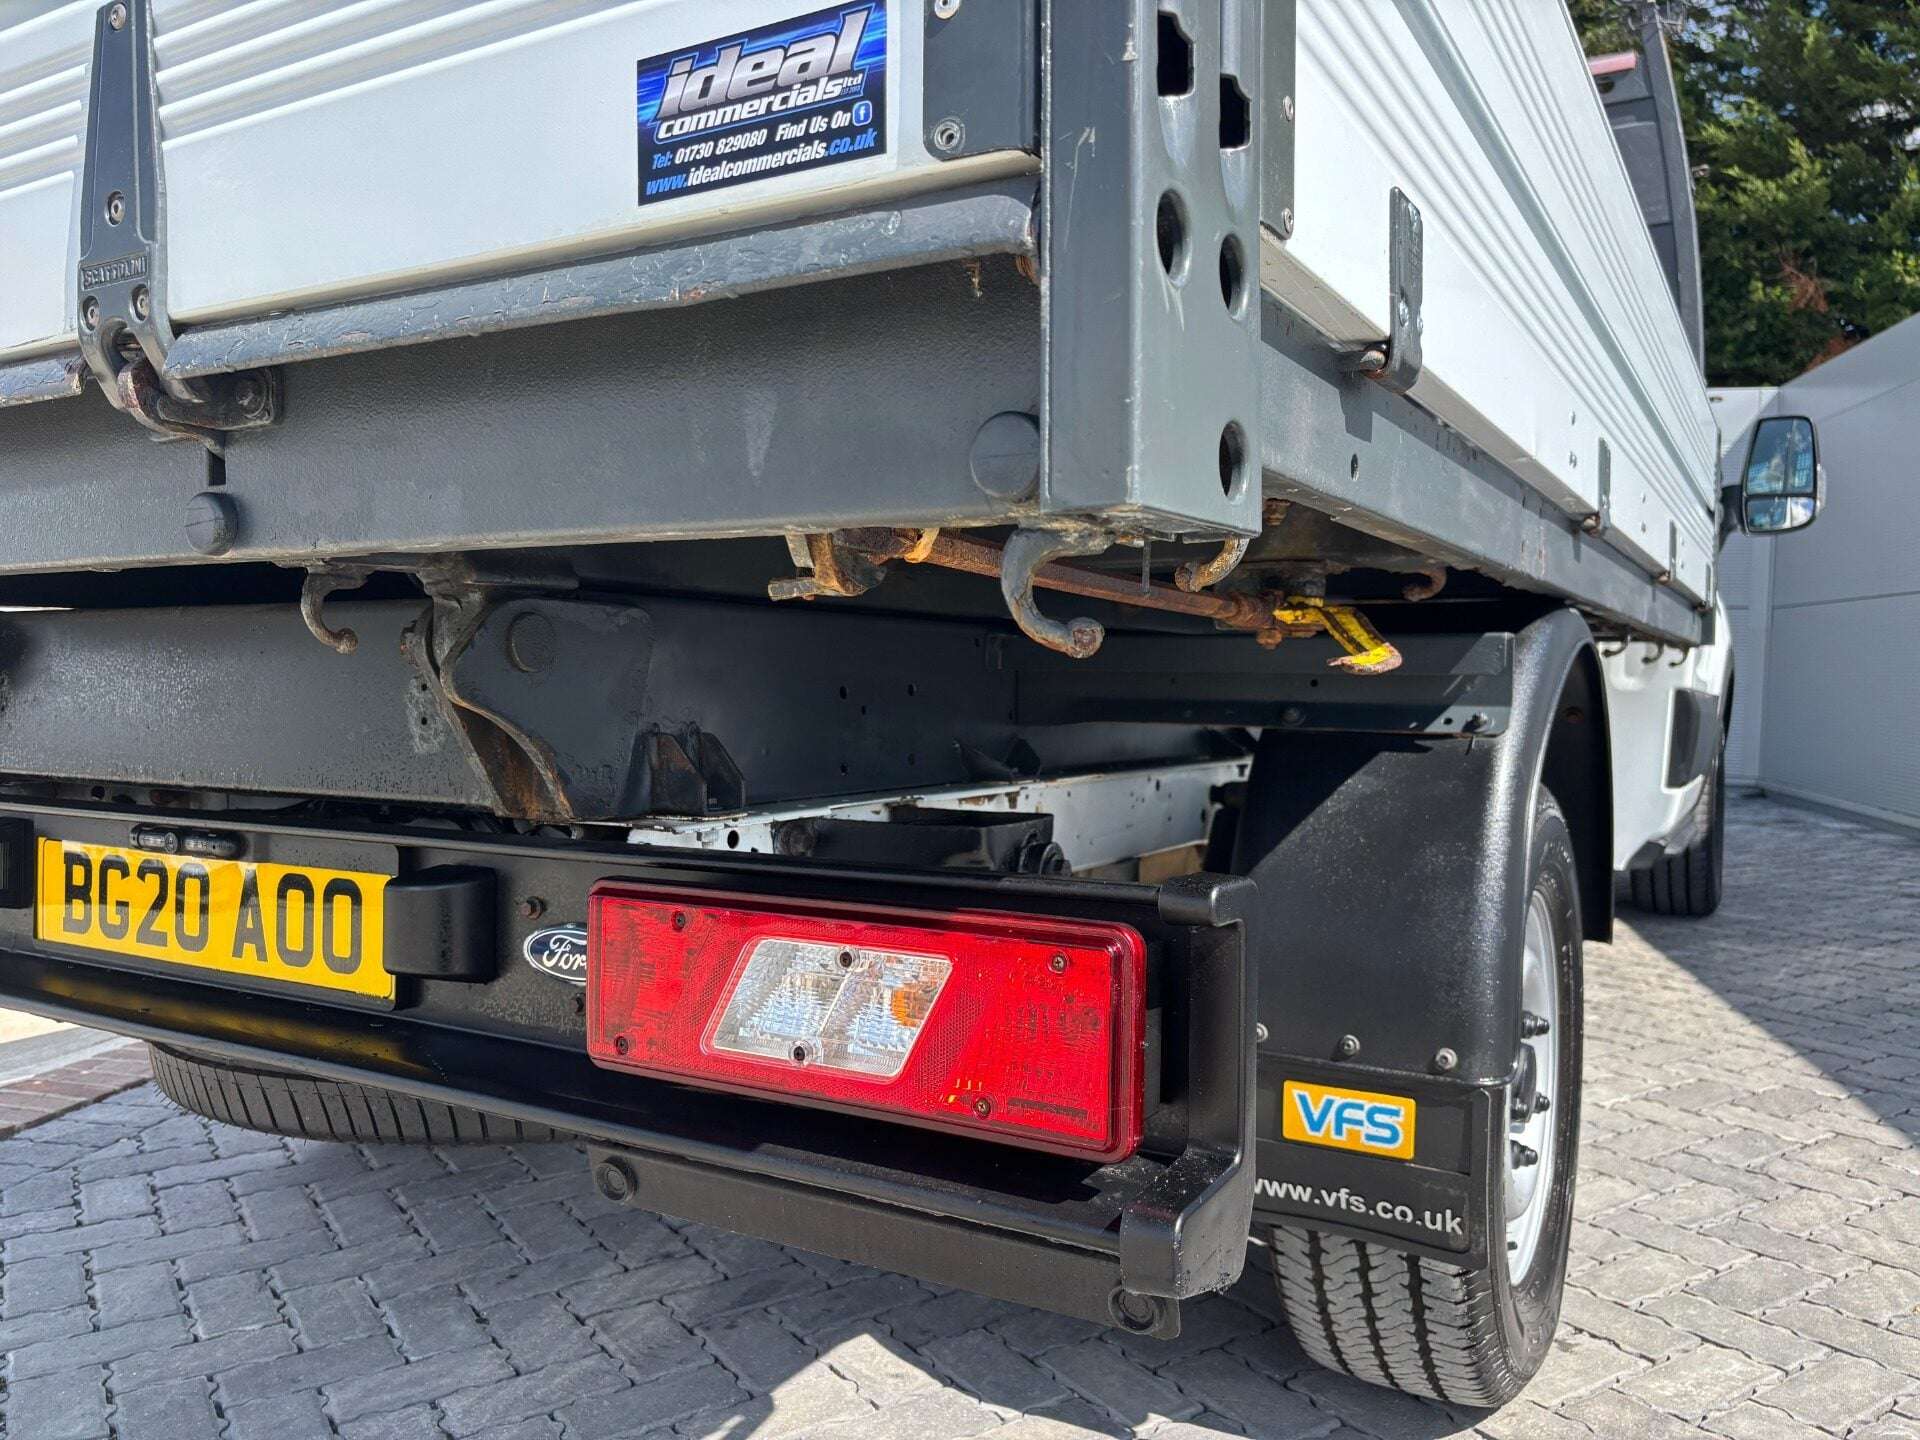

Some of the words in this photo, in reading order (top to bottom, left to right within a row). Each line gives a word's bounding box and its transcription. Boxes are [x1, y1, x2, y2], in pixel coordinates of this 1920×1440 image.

[657, 10, 870, 119] ideal
[657, 77, 843, 139] commercials
[842, 73, 862, 87] ltd
[646, 128, 877, 195] www.idealcommercials.co.uk
[652, 152, 672, 170] Tel:
[675, 142, 713, 165] 01730
[715, 129, 768, 158] 829080
[775, 118, 806, 142] Find
[809, 115, 828, 133] Us
[831, 110, 851, 129] On
[63, 852, 209, 951] BG20
[543, 935, 587, 970] For
[1294, 1090, 1404, 1148] VFS
